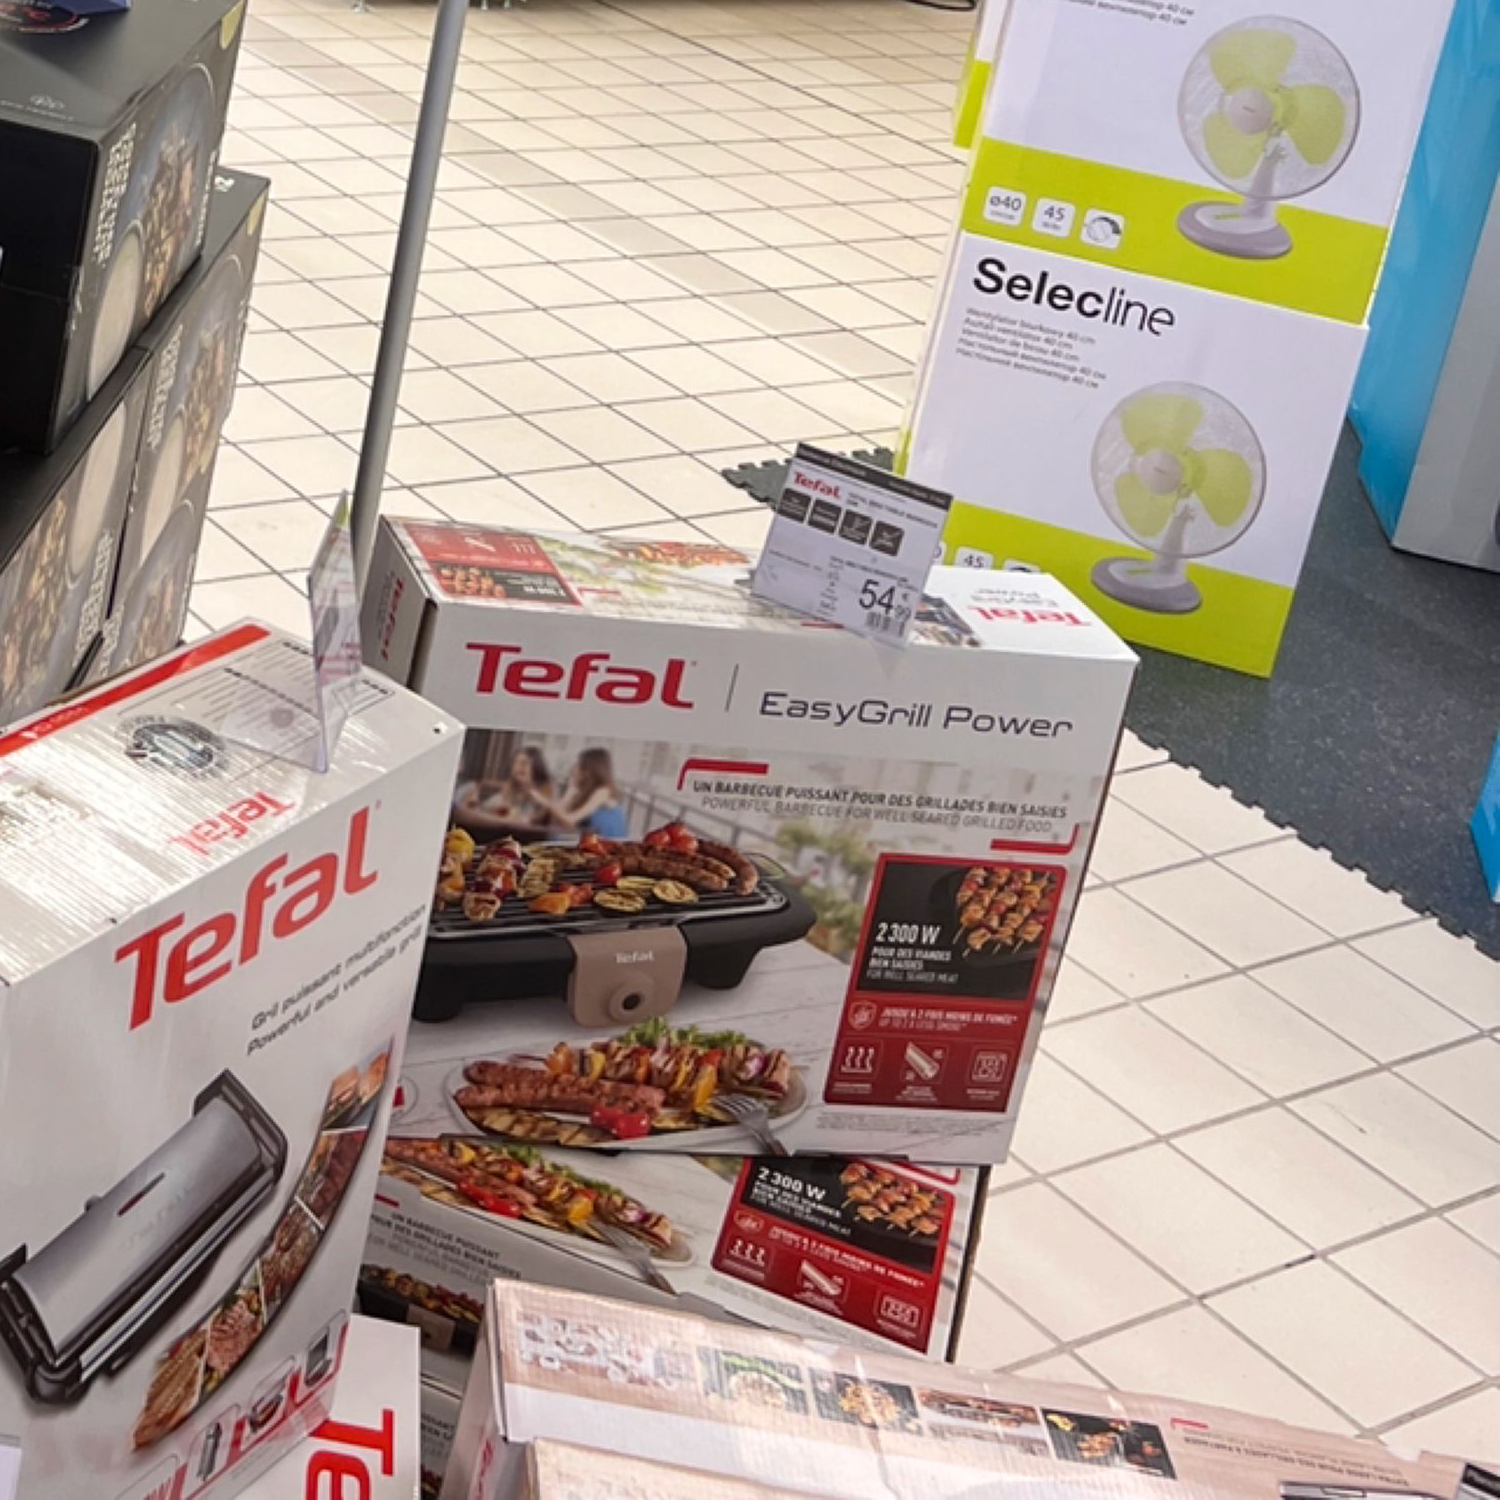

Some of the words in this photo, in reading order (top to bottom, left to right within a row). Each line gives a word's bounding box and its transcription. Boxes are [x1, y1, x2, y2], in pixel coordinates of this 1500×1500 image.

[1044, 204, 1065, 223] 45
[972, 256, 1176, 337] Selecline
[793, 470, 841, 499] Tefal
[466, 642, 694, 708] Tefal
[759, 691, 931, 730] EasyGrill
[943, 705, 1074, 740] Power
[693, 780, 711, 792] UN
[713, 781, 782, 798] BARBECUE
[785, 787, 848, 803] PUISSANT
[850, 790, 885, 805] POUR
[887, 794, 912, 807] DES
[915, 795, 984, 813] GRILLADES
[986, 800, 1017, 814] BIEN
[1020, 803, 1068, 819] SAISIES
[702, 796, 769, 813] POWERFUL
[774, 801, 842, 818] BARBECUE
[844, 805, 871, 819] FOR
[873, 808, 907, 822] WELL
[911, 809, 959, 826] SEARED
[962, 814, 1018, 831] GRILLED
[1018, 817, 1051, 833] FOOD
[114, 805, 379, 1031] Tefal
[921, 925, 940, 944] W
[281, 963, 342, 1015] puissant
[345, 904, 426, 968] multifonction
[615, 948, 656, 966] Tefal
[246, 1003, 311, 1056] Powerful
[314, 985, 341, 1012] and
[343, 946, 397, 991] versatile
[806, 1182, 827, 1201] W
